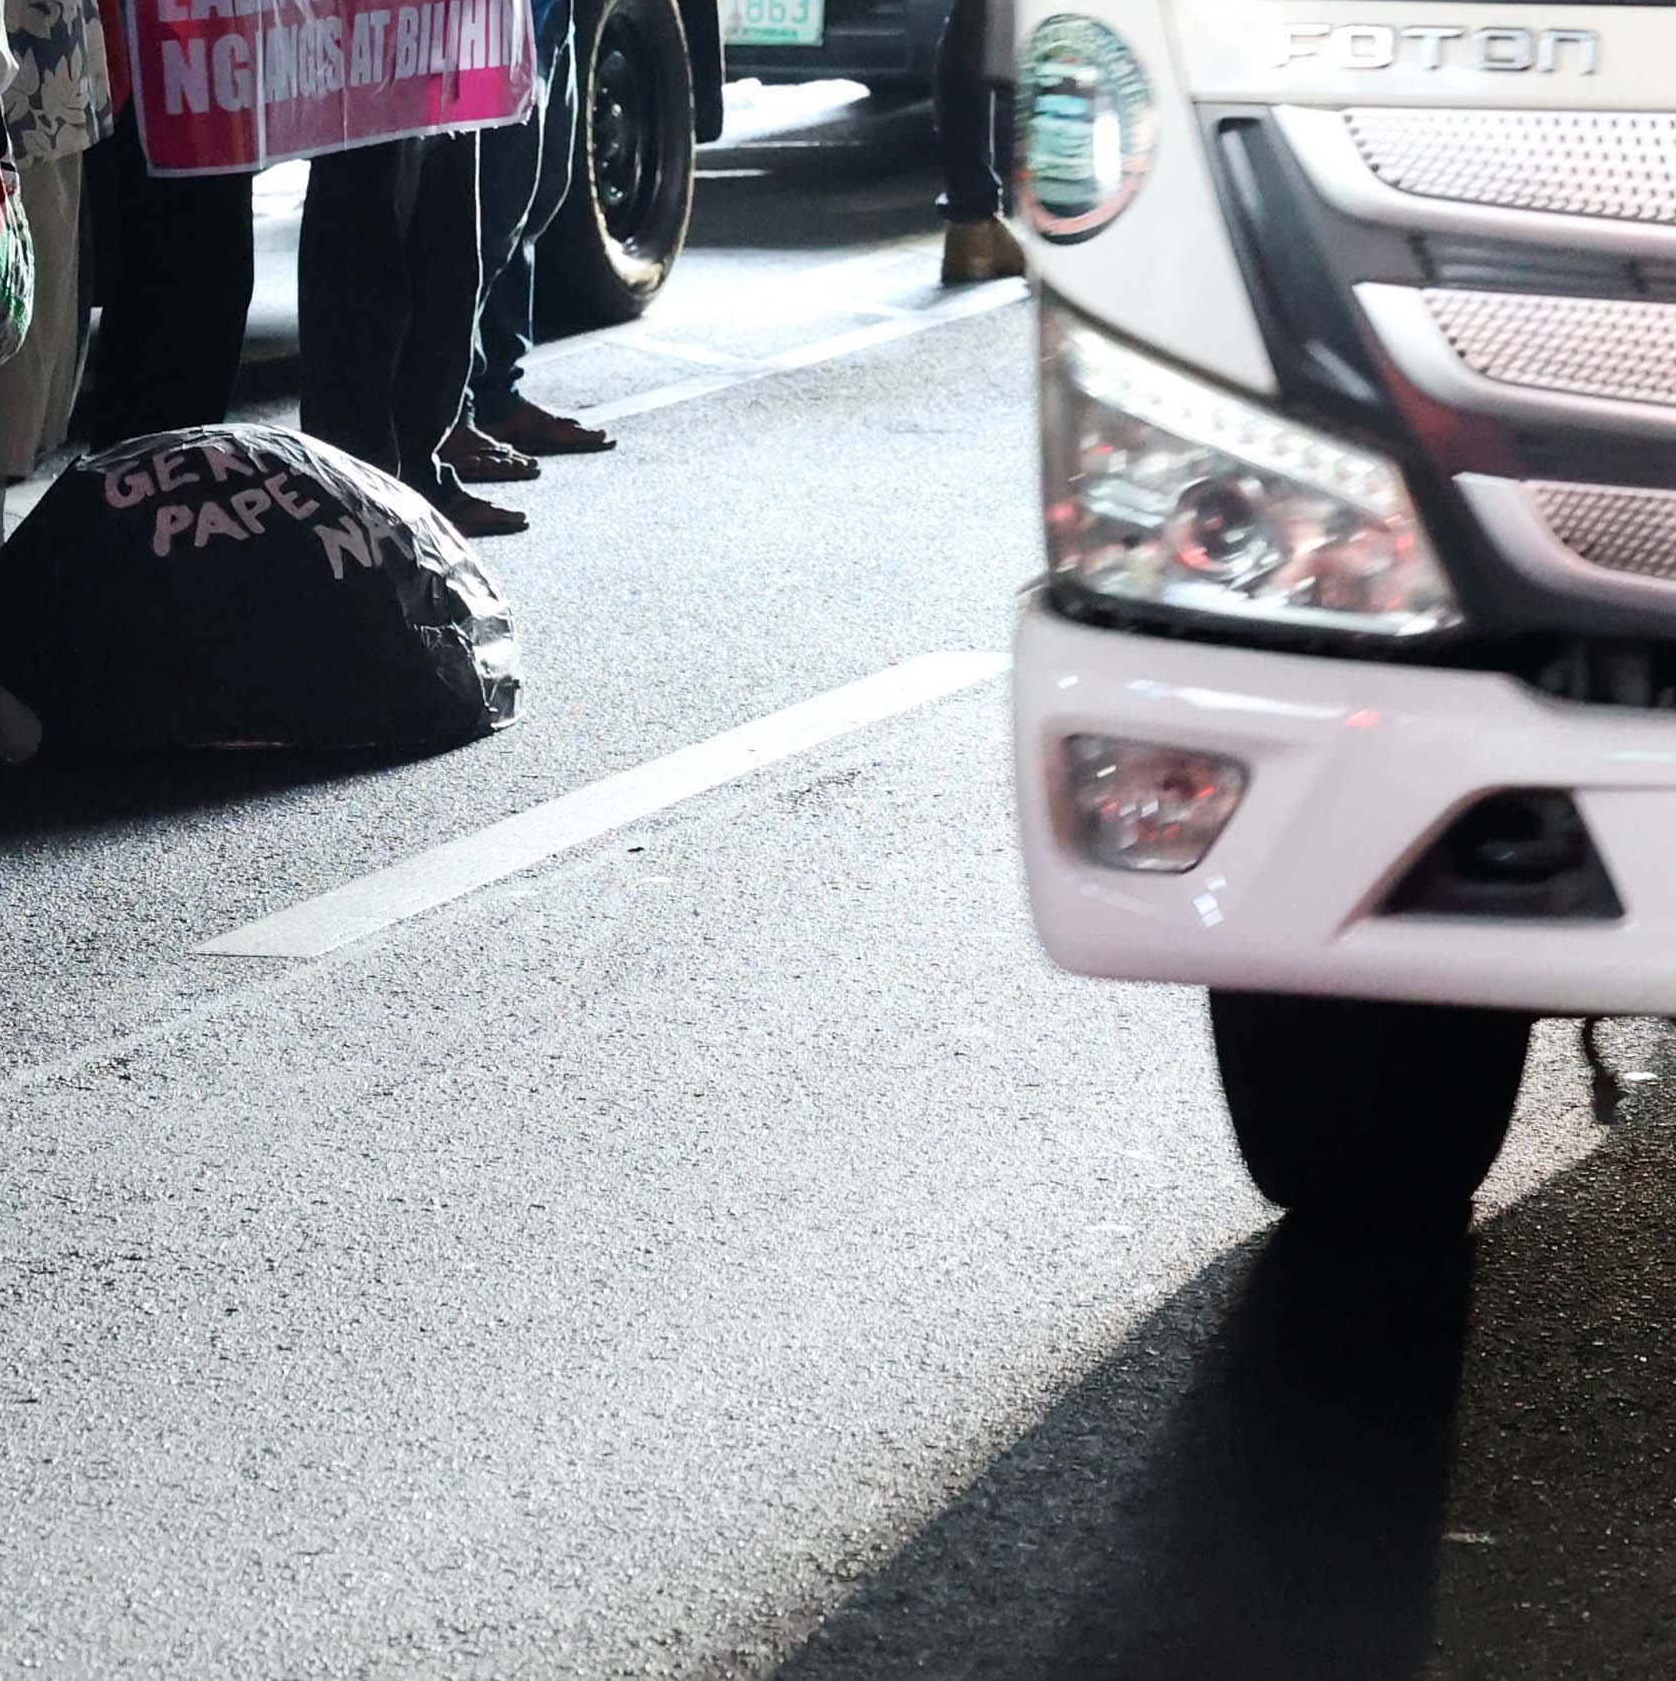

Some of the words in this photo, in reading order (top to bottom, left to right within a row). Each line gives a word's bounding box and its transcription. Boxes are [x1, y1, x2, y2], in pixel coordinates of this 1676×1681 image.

[161, 32, 253, 115] NG
[350, 8, 391, 88] AT
[1273, 23, 1600, 76] FOTON
